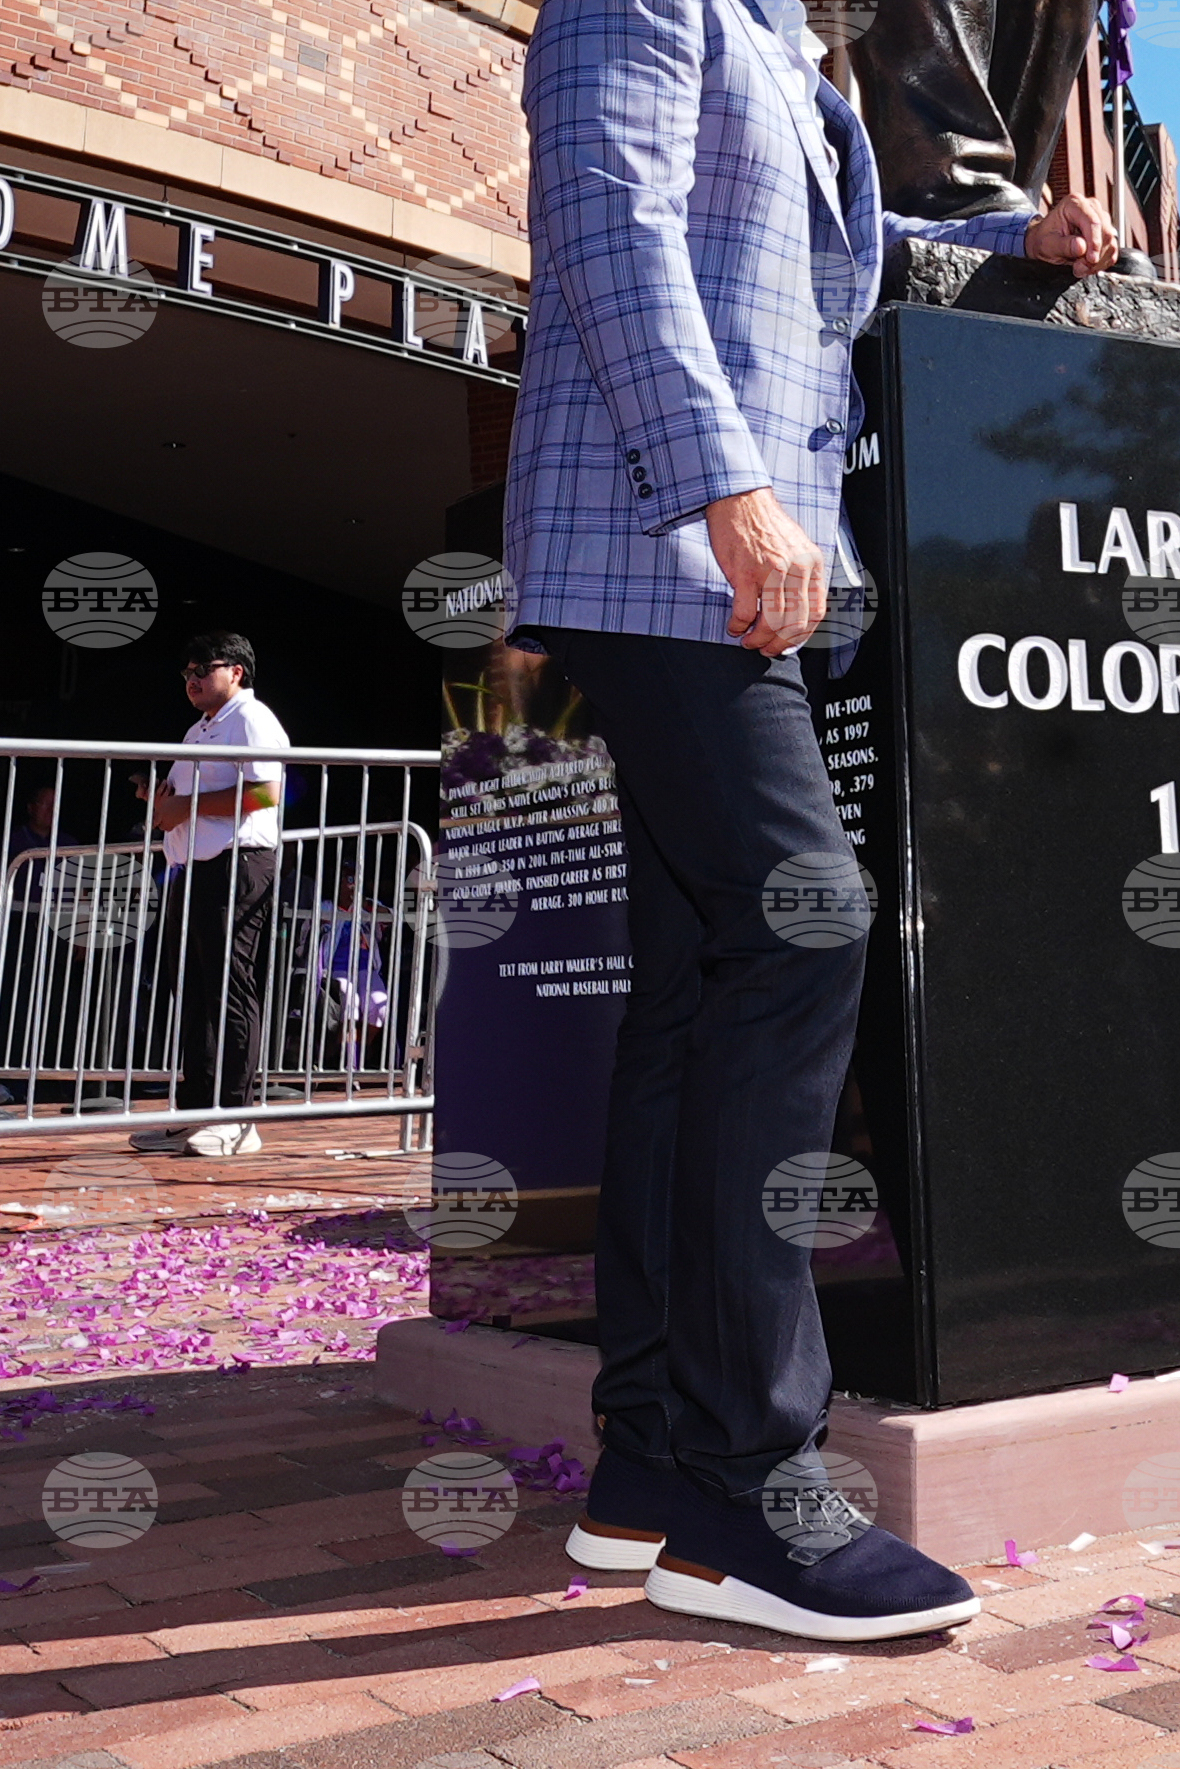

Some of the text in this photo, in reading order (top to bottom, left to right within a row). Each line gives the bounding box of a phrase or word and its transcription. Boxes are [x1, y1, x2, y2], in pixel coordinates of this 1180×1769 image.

[825, 727, 840, 745] AS
[844, 721, 870, 741] 1997
[827, 746, 879, 771] SEASONS.
[536, 828, 566, 846] BATTING
[567, 821, 600, 841] AVERAGE
[850, 773, 875, 794] .379
[560, 868, 590, 886] CAREER
[592, 867, 602, 881] AS
[604, 863, 628, 880] FIRST
[567, 892, 583, 907] 300
[585, 889, 609, 905] HOME
[499, 963, 516, 977] TEXT
[518, 961, 538, 976] FROM
[540, 959, 565, 975] LARRY
[566, 956, 604, 973] WALKER'S
[606, 955, 626, 970] HALL
[536, 982, 571, 997] NATIONAL
[572, 980, 609, 996] BASEBALL
